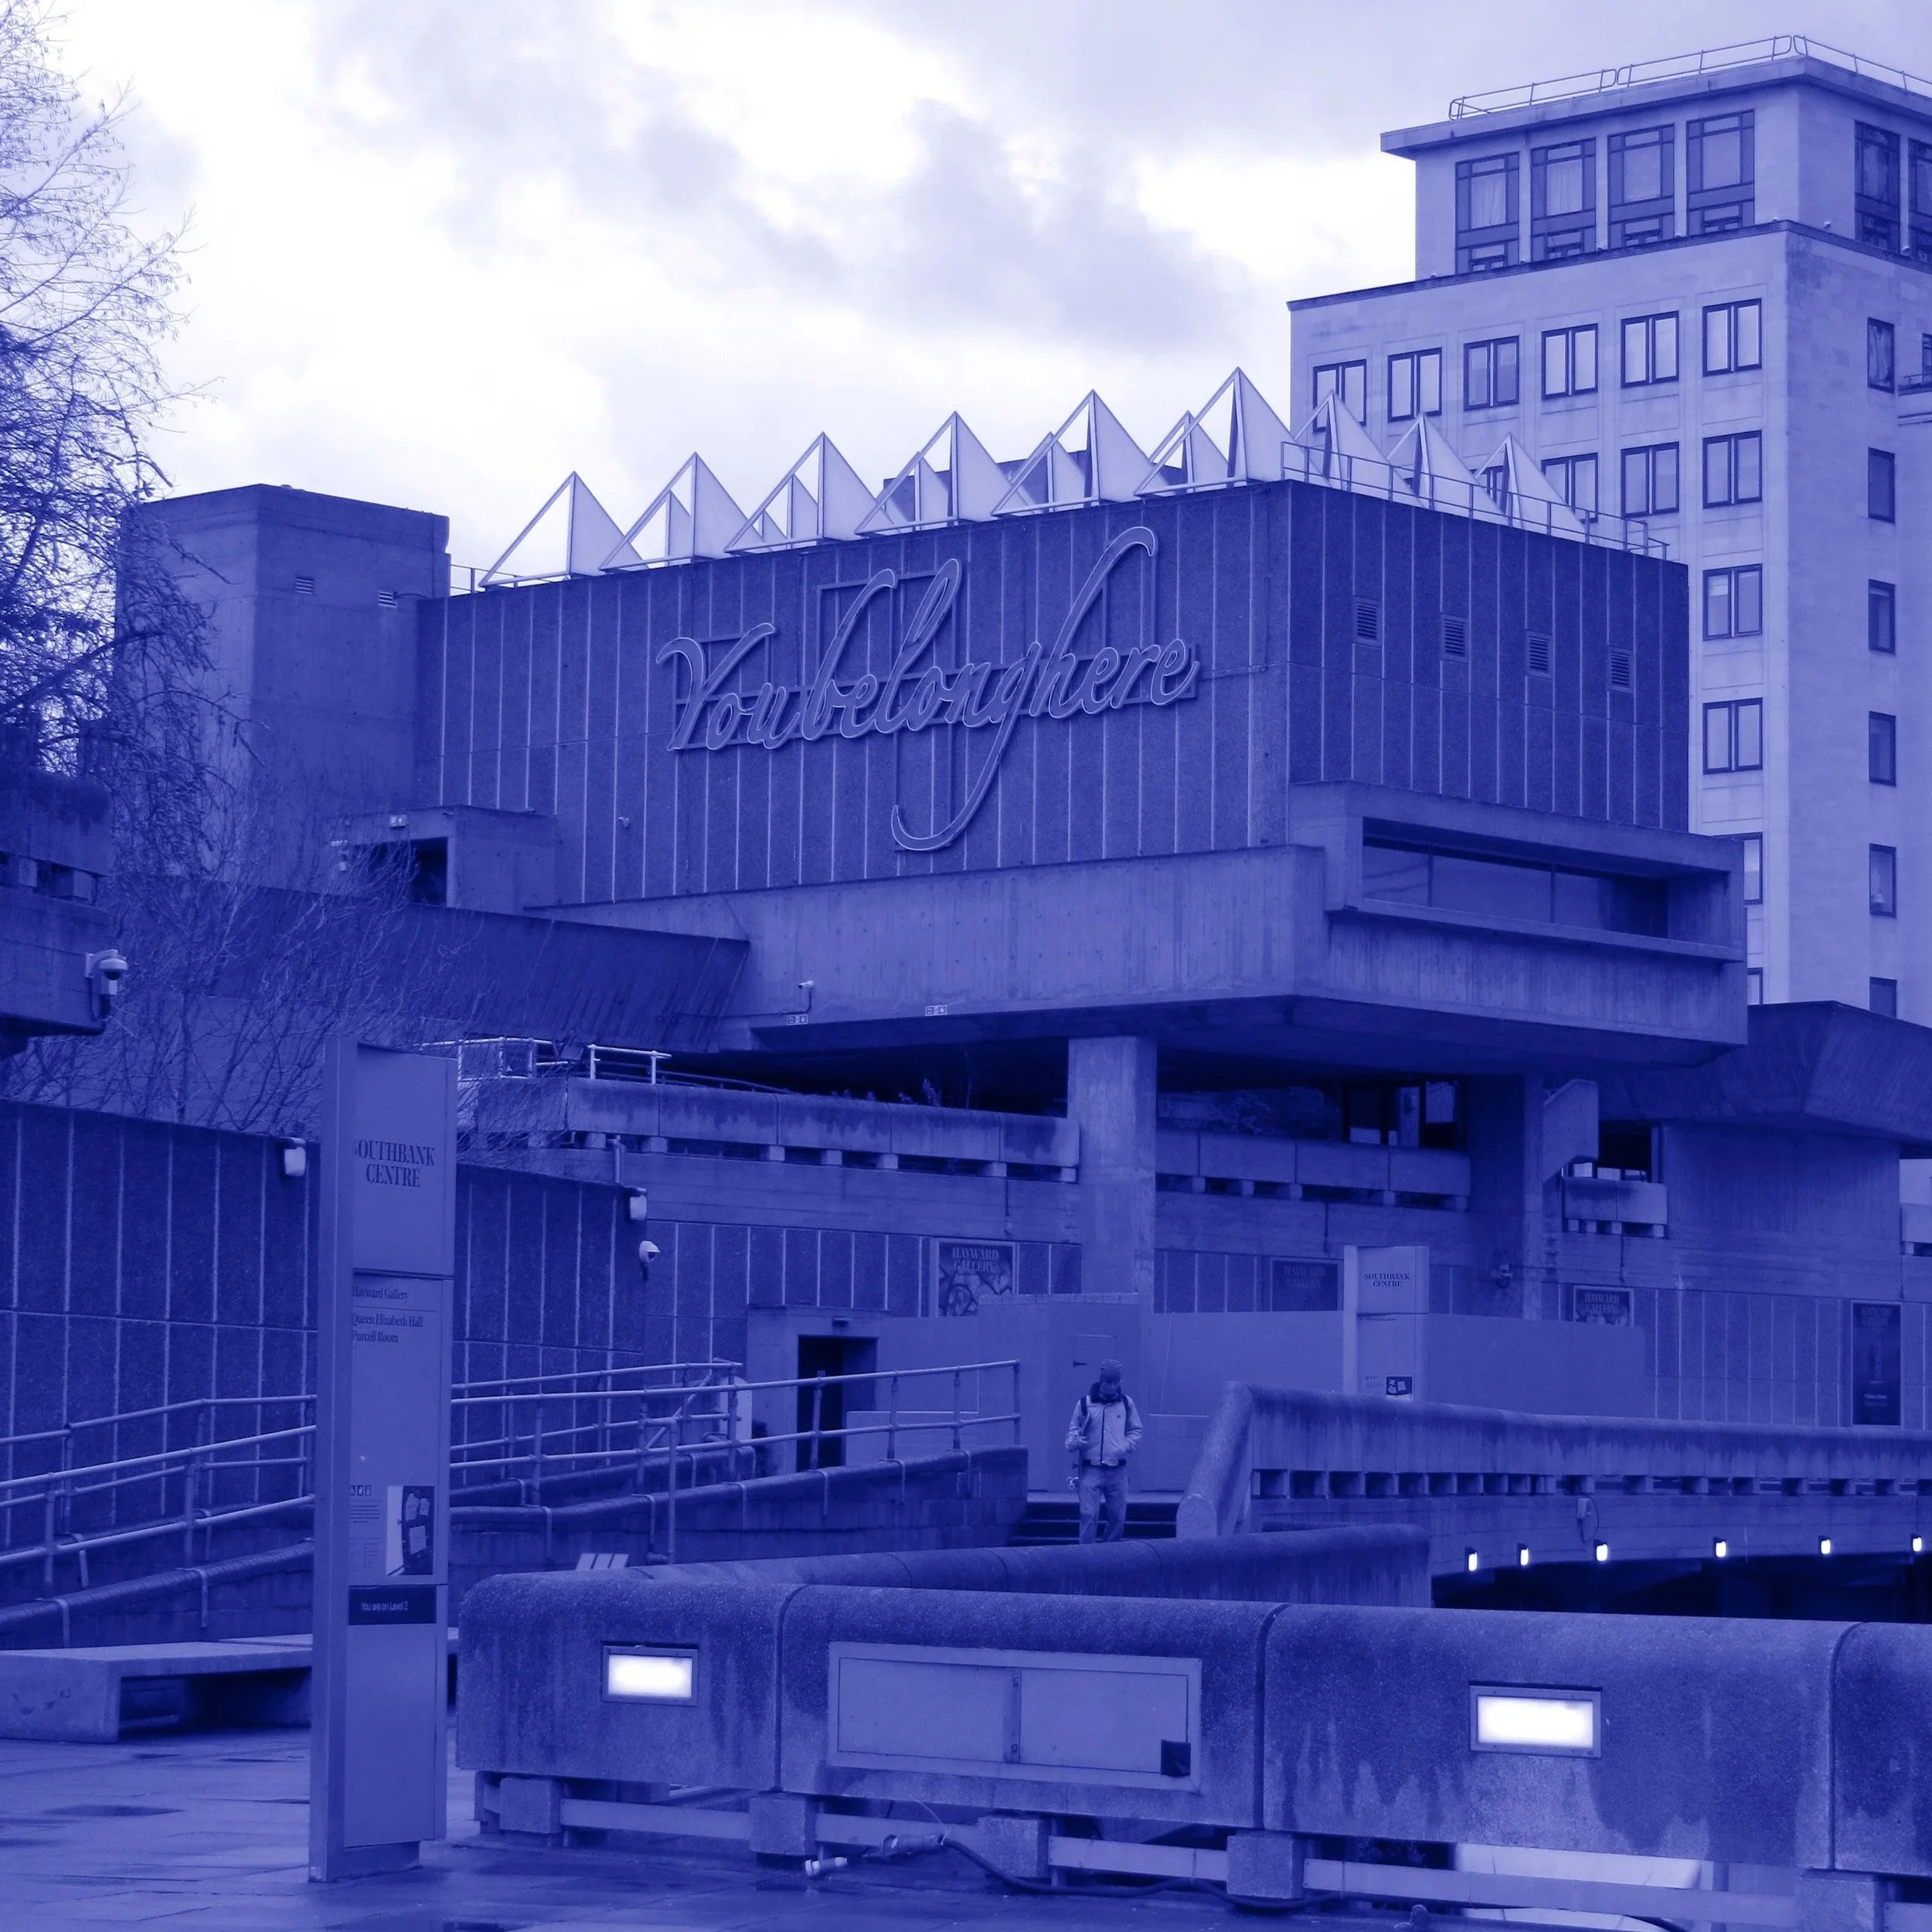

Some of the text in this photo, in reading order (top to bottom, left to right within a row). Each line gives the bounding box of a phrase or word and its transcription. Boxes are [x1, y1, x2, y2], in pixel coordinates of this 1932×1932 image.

[355, 1139, 436, 1166] OUTHBANK
[366, 1163, 420, 1188] CENTRE
[952, 1247, 999, 1260] HAYWARD
[384, 1287, 409, 1303] Gallery
[376, 1314, 407, 1326] Elizabeth
[409, 1315, 423, 1328] Hall
[377, 1332, 399, 1343] Room
[361, 1600, 372, 1611] You
[372, 1603, 381, 1611] are
[382, 1603, 389, 1611] on
[389, 1600, 403, 1611] Level
